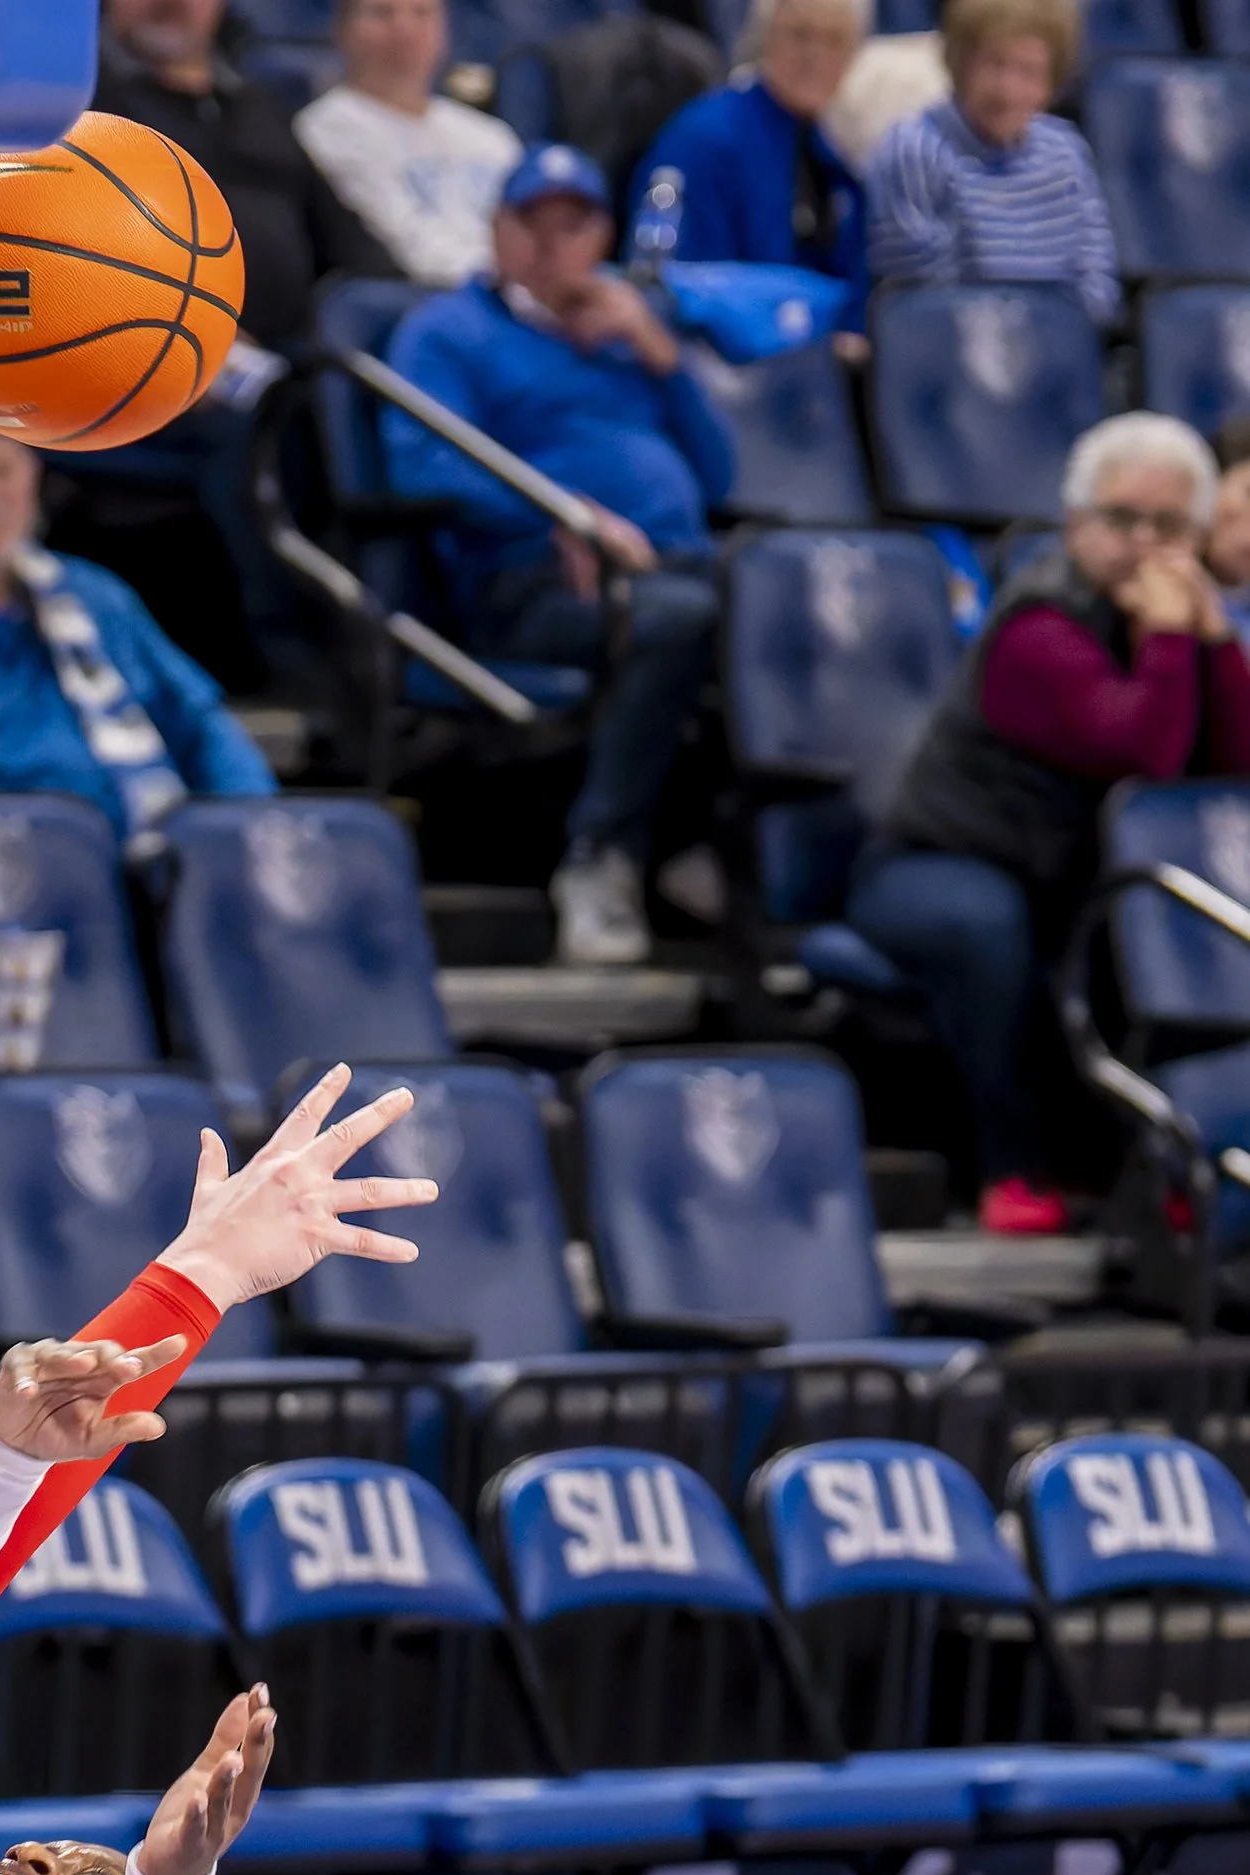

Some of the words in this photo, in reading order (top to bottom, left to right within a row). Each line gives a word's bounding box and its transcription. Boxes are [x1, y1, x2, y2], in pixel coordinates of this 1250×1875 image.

[11, 1486, 147, 1598] LU
[271, 1477, 428, 1590] SLU
[547, 1465, 698, 1577] SLU
[806, 1457, 956, 1566] SLU
[1067, 1451, 1216, 1558] SLU
